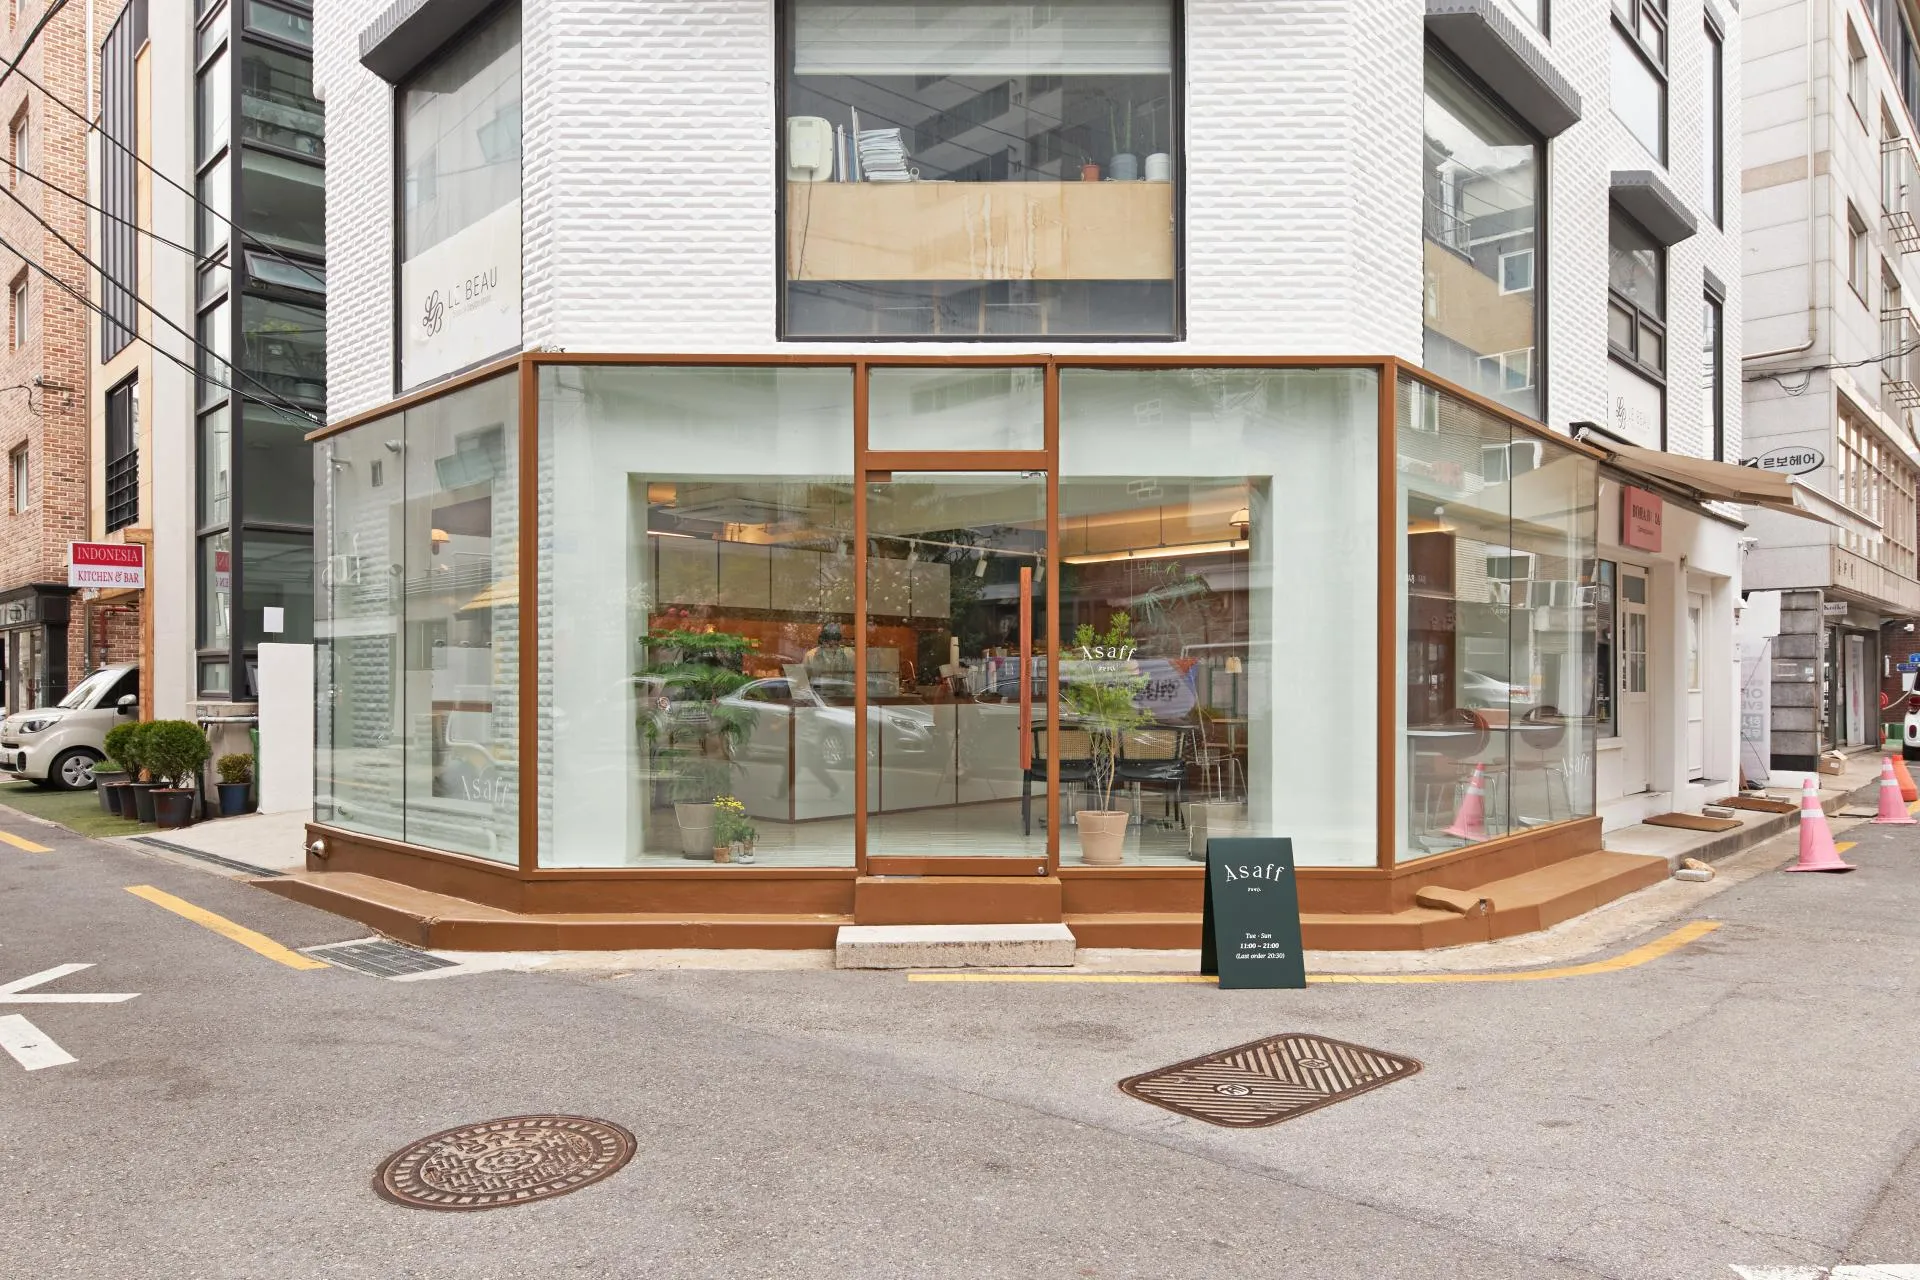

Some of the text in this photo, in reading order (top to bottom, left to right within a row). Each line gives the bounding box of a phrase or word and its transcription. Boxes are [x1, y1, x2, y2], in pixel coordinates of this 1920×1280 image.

[465, 265, 498, 301] BEAU
[1763, 453, 1816, 469] 르보헤어
[77, 547, 139, 563] INDONESIA
[78, 570, 114, 583] KITCHEN
[123, 572, 139, 584] BAR
[1082, 645, 1137, 661] Asaff
[1224, 863, 1285, 882] Asaff
